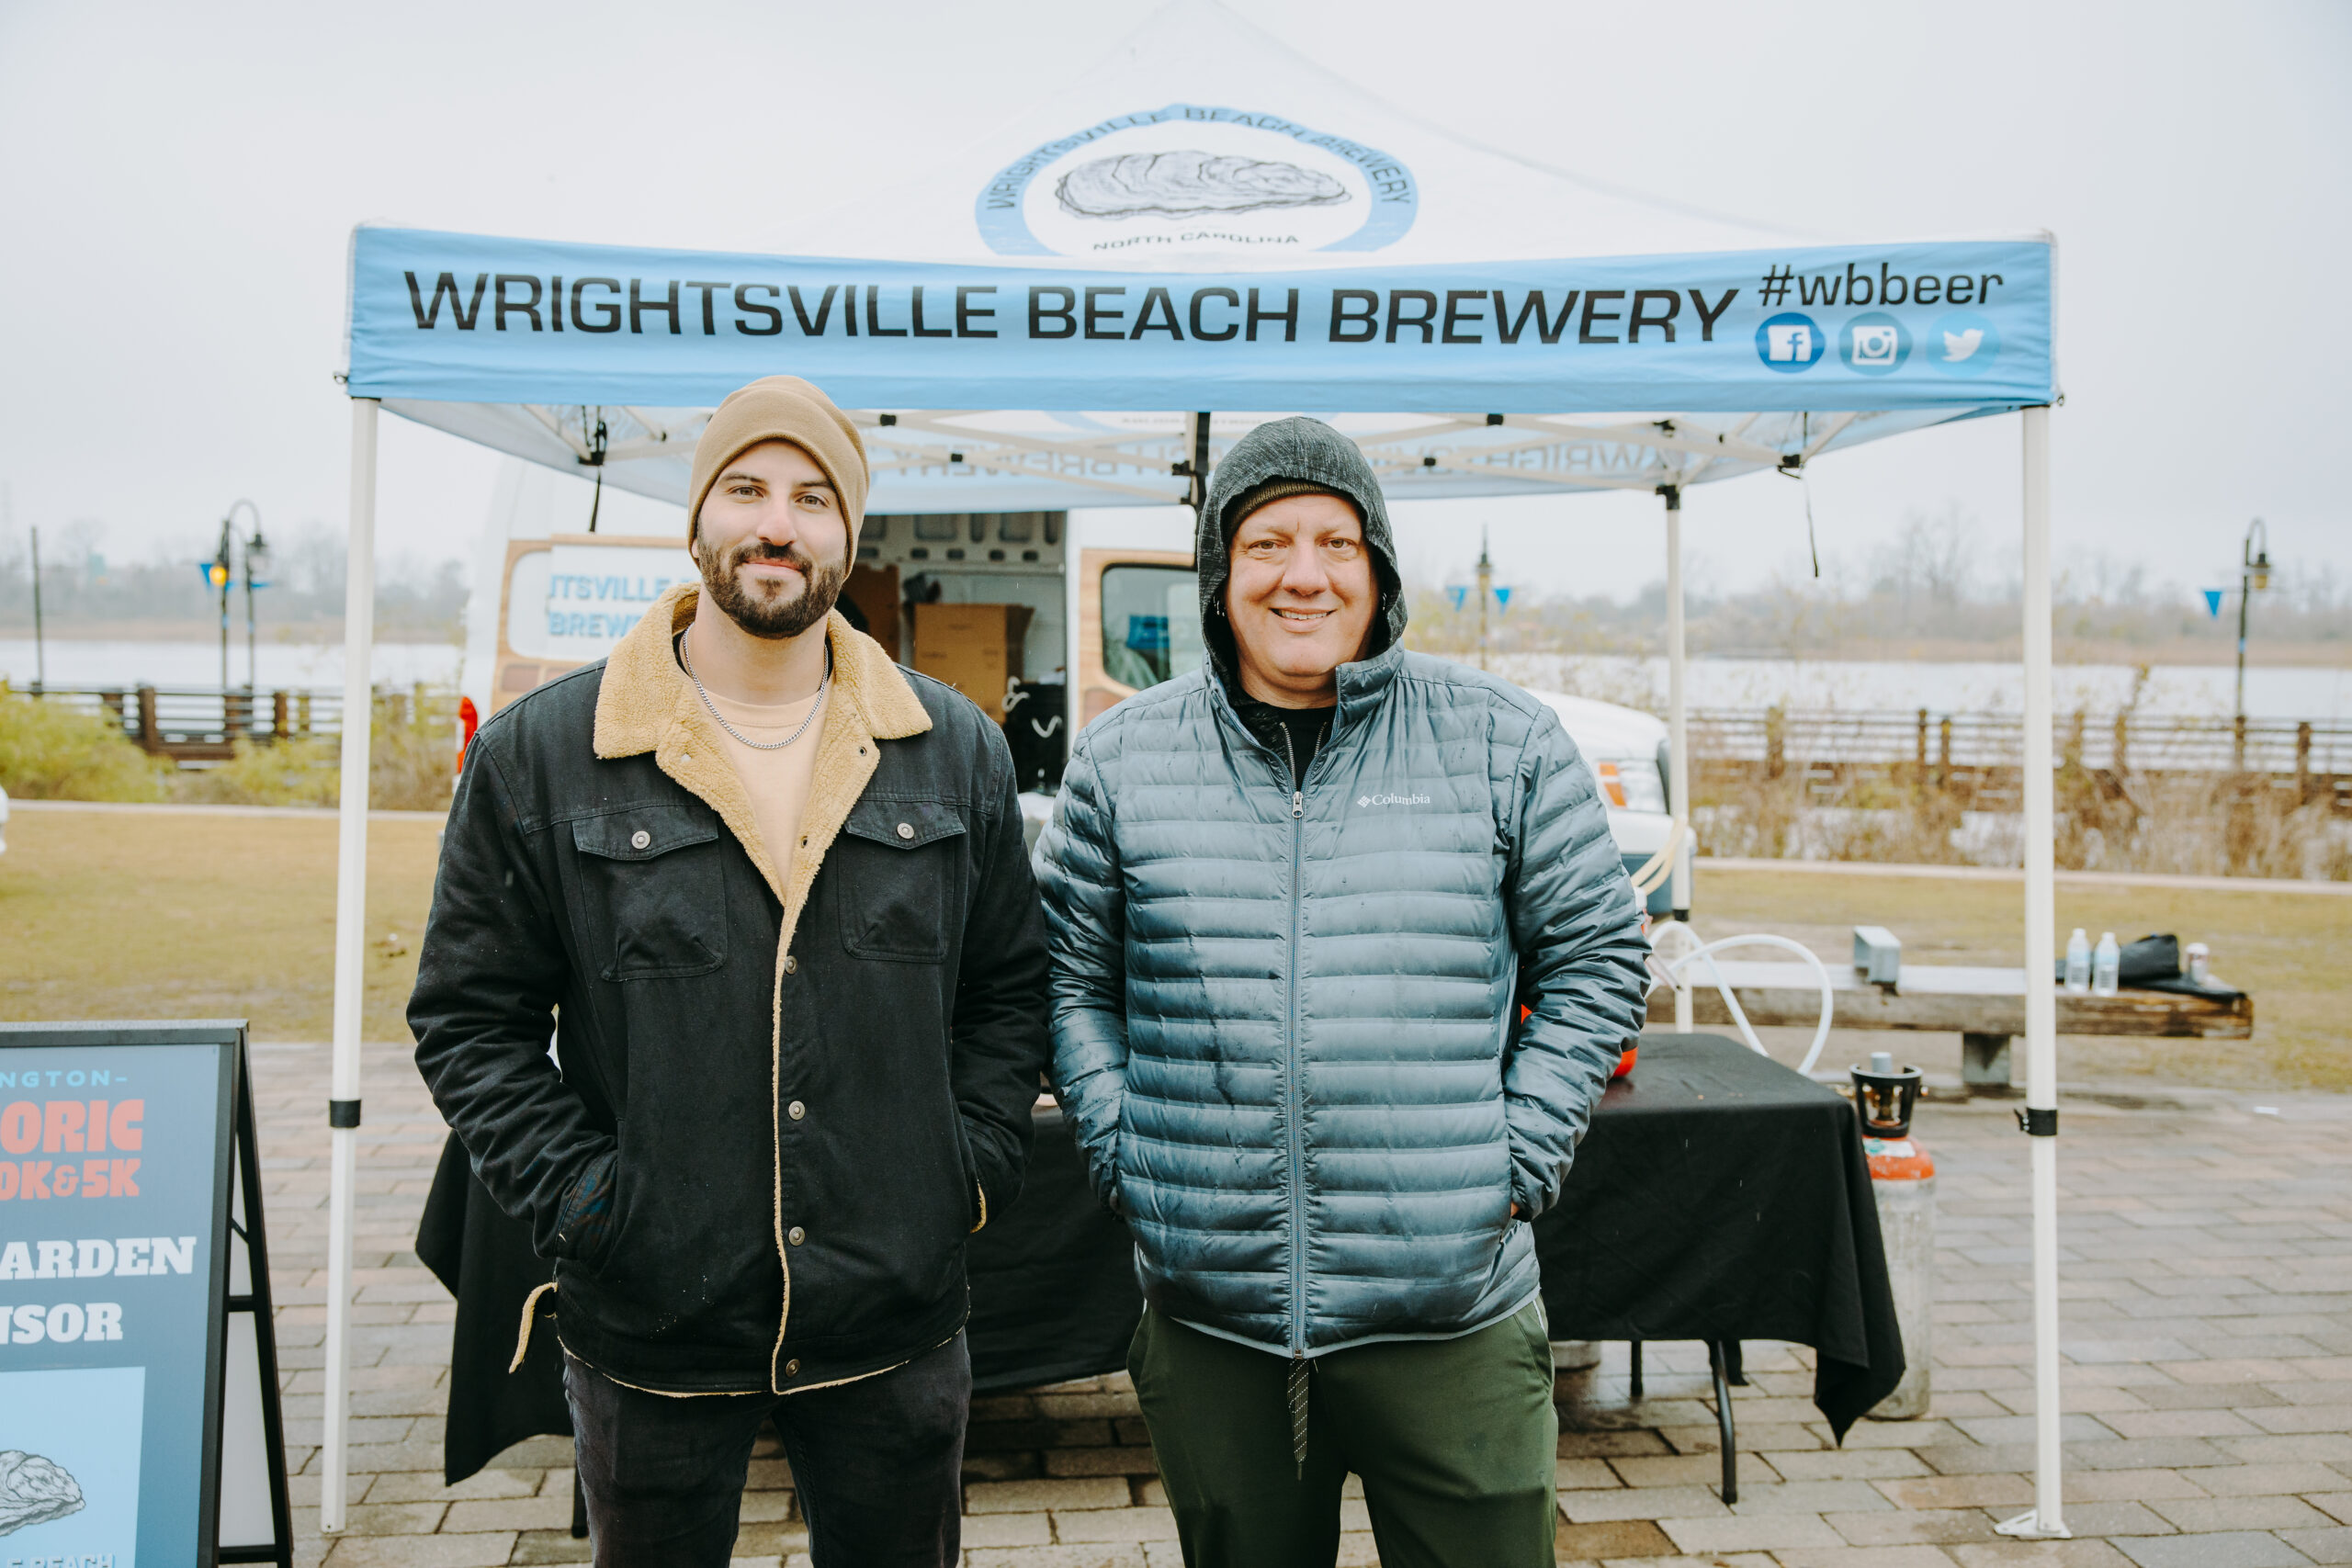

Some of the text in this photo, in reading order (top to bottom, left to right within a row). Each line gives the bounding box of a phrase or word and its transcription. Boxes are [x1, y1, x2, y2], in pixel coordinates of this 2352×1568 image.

[986, 107, 1412, 209] WRIGHTSVILLE BEACH BREWERY
[1092, 231, 1300, 250] NORTH CAROLINA
[1758, 263, 2004, 306] #wbbeer
[404, 271, 1739, 344] WRIGHTSVILLE BEACH BREWERY
[548, 611, 644, 638] BREW
[1372, 793, 1430, 806] Columbia
[0, 1099, 144, 1155] ORIC
[0, 1236, 197, 1280] ARDEN
